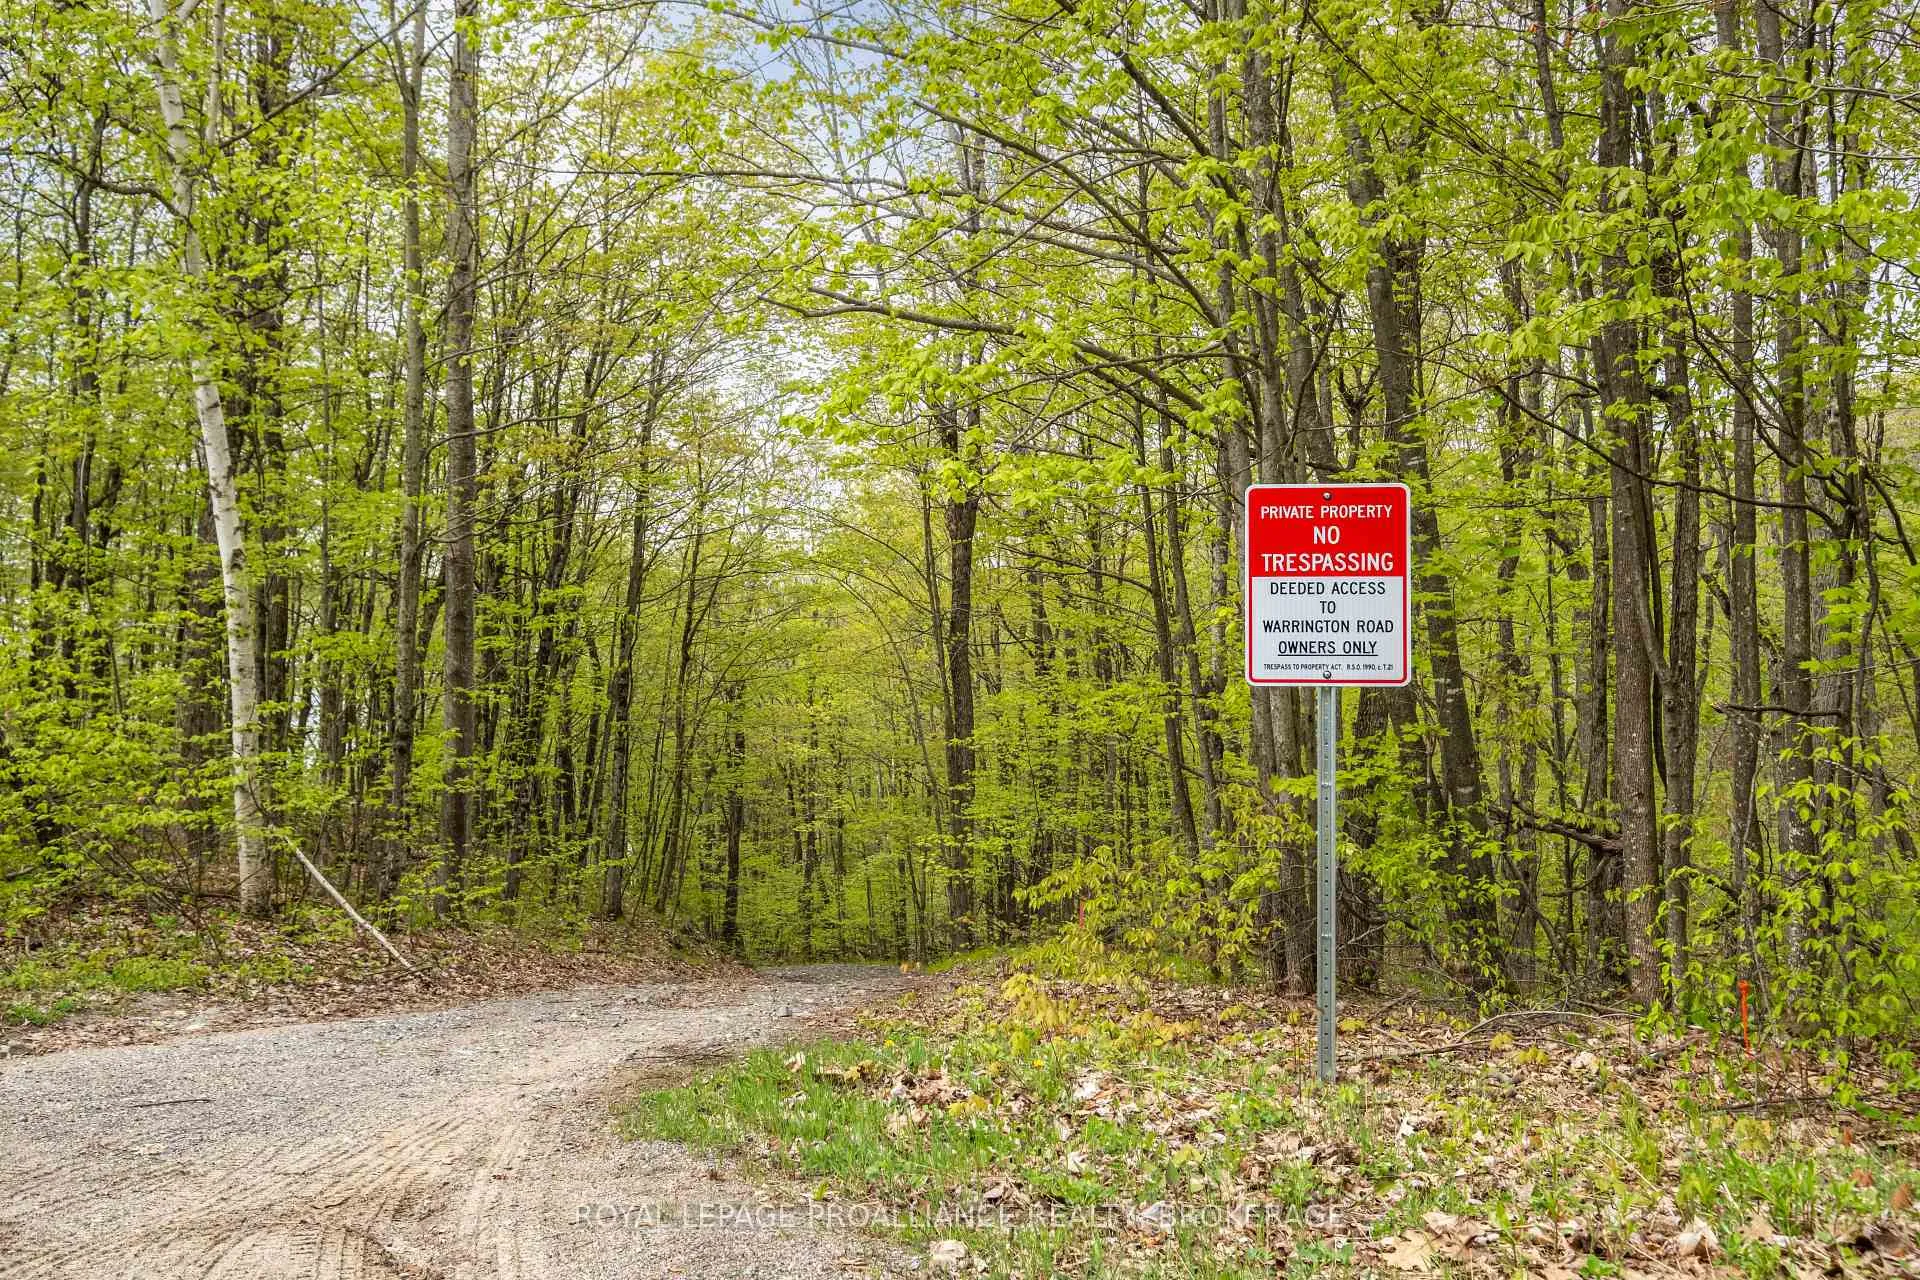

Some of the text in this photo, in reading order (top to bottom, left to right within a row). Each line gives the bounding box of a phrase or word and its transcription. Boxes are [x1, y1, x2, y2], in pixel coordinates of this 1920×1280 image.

[1260, 504, 1393, 520] PRIVATE PROPERTY
[1313, 525, 1341, 545] NO
[1261, 553, 1394, 573] TRESPASSING
[1270, 582, 1386, 595] DEEDED ACCESS
[1319, 600, 1336, 614] TO
[1263, 620, 1394, 633] WARRINGTON ROAD
[1278, 641, 1378, 654] OWNERS ONLY
[1264, 663, 1291, 671] TRESPASS
[1292, 663, 1300, 671] TO
[1300, 663, 1329, 671] PROPERTY
